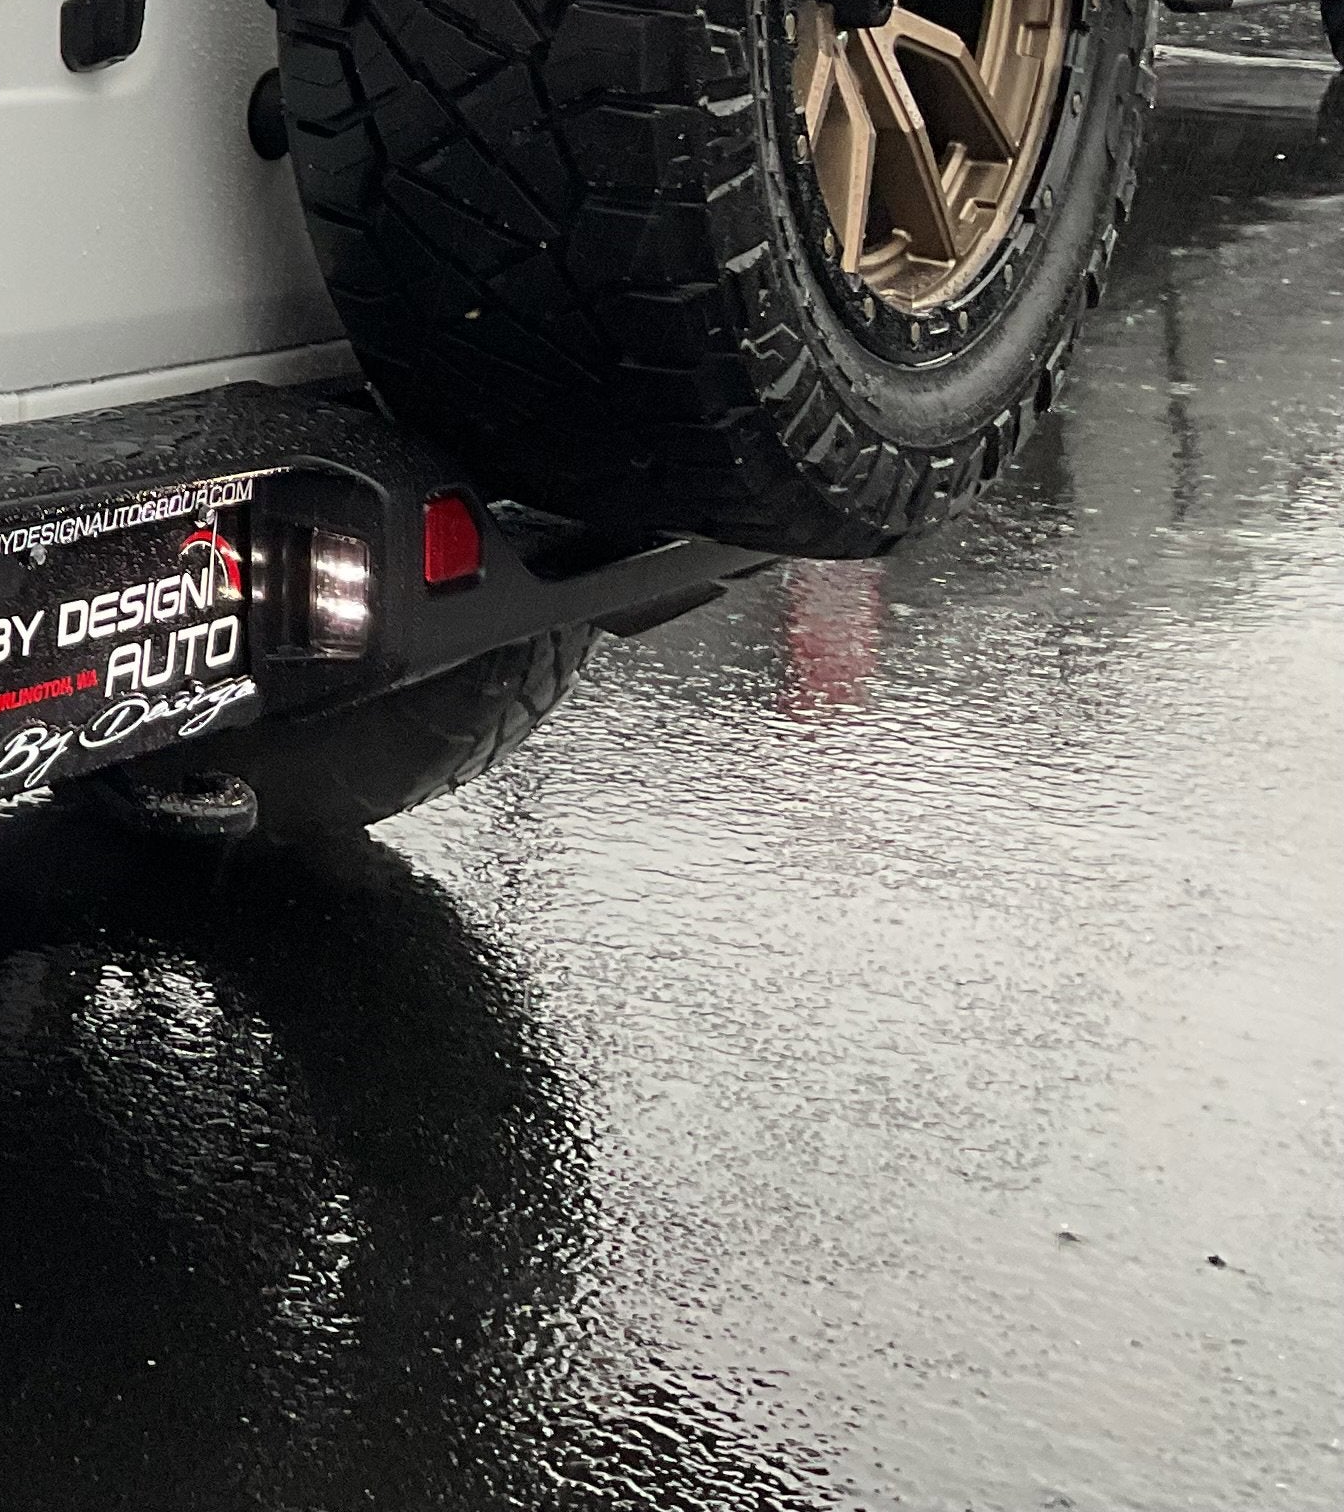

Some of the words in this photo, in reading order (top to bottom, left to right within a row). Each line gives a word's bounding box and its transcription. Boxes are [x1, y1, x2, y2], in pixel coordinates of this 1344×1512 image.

[57, 567, 211, 648] DESIGN
[76, 668, 99, 690] WA
[104, 614, 239, 698] AUTO
[78, 676, 258, 748] Design
